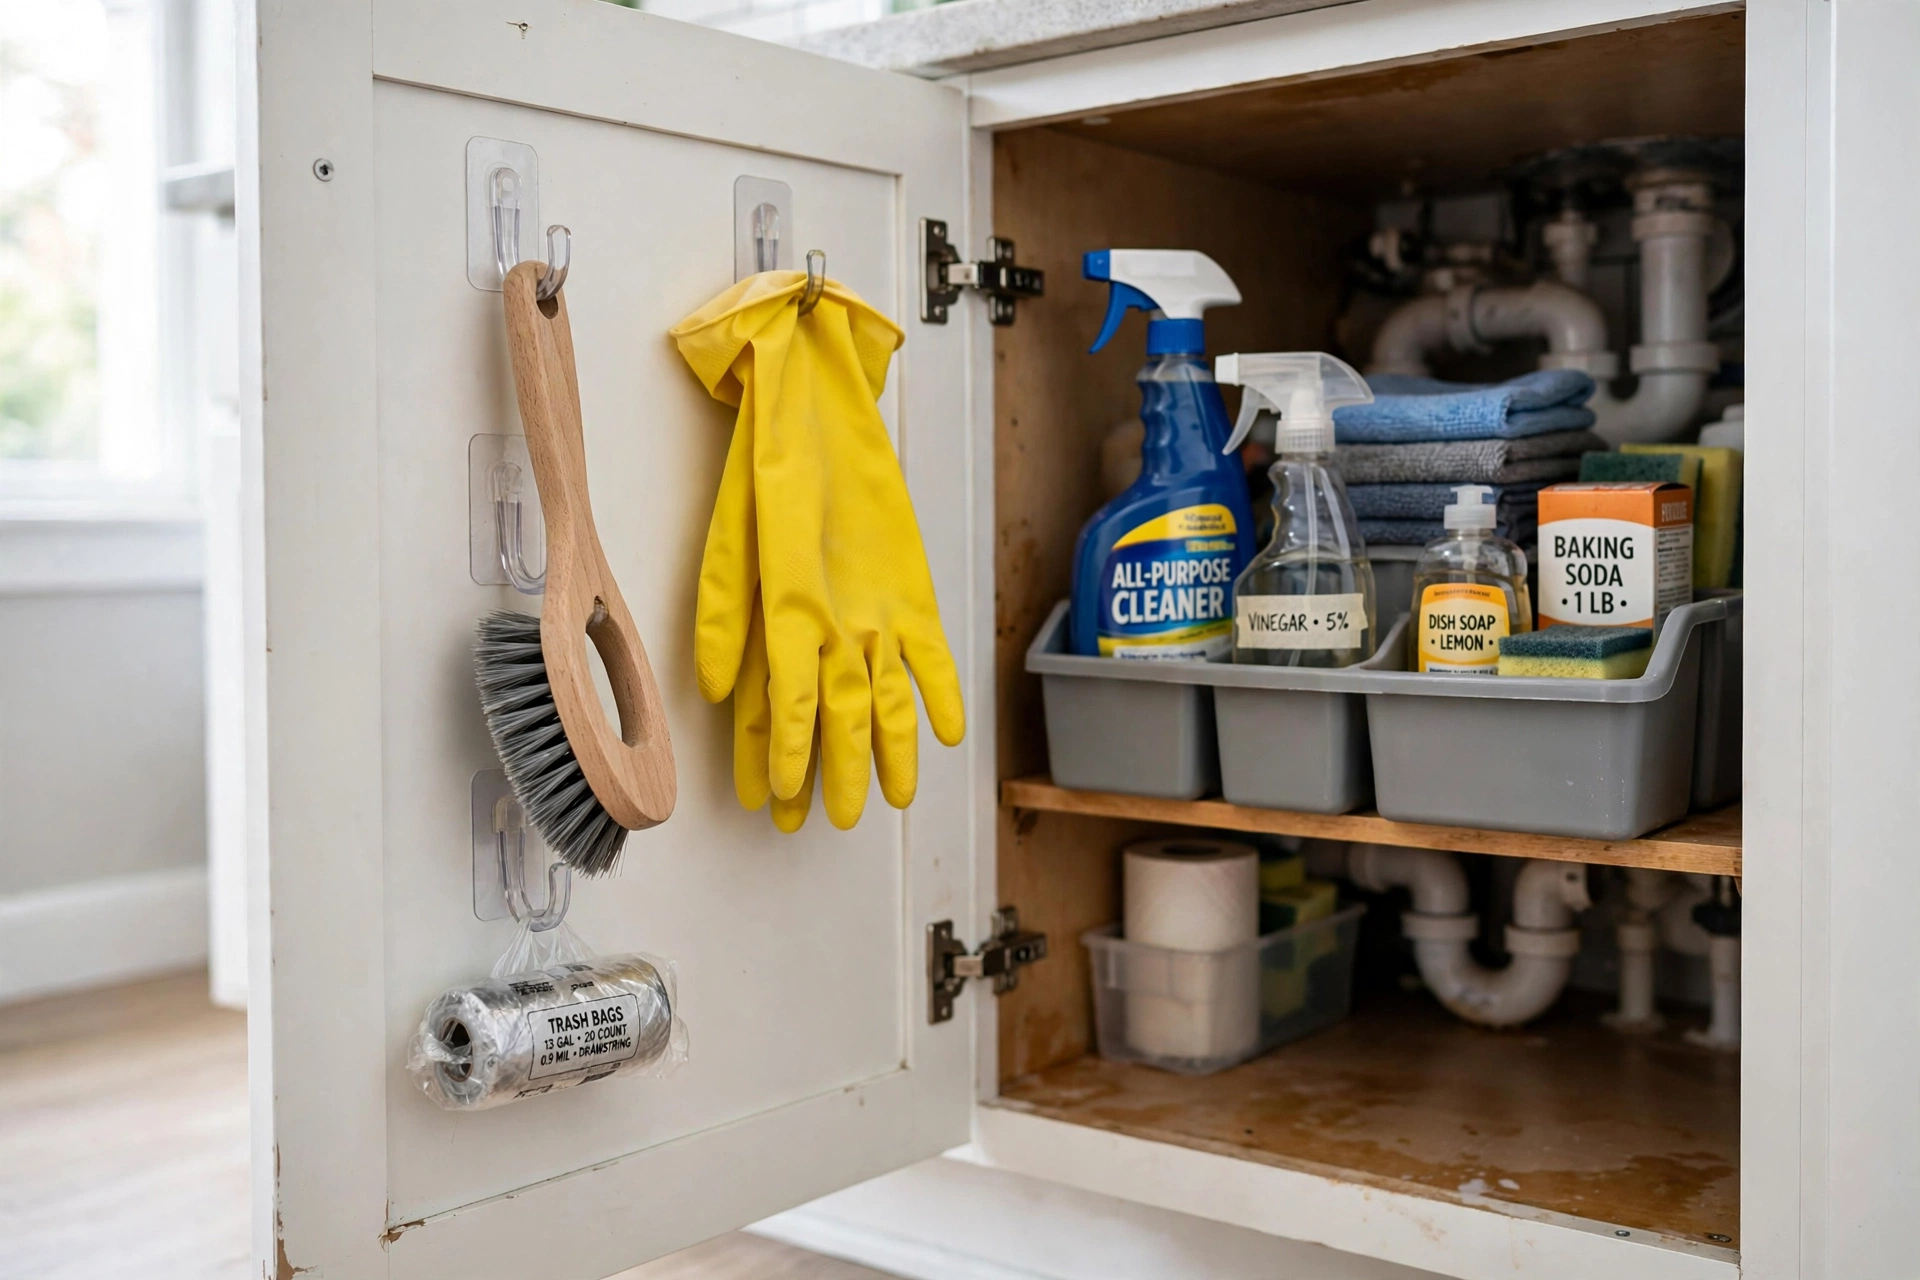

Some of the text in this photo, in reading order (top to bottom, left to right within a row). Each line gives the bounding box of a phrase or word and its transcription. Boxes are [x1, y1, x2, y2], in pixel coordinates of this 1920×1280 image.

[1554, 535, 1635, 560] BAKING
[1111, 557, 1232, 589] ALL-PURPOSE
[1565, 563, 1624, 587] SODA
[1111, 586, 1225, 625] CLEANER
[1574, 591, 1615, 614] 1 LB
[1247, 611, 1309, 632] VINEGAR
[1326, 611, 1350, 631] 5%
[1429, 614, 1497, 631] DISH SOAP
[1440, 634, 1484, 651] LEMON
[547, 1005, 625, 1035] TRASH BAGS
[544, 1023, 628, 1050] 13 GAL 20 COUNT
[540, 1036, 632, 1066] 0.9 MIL DRAWSTRING
